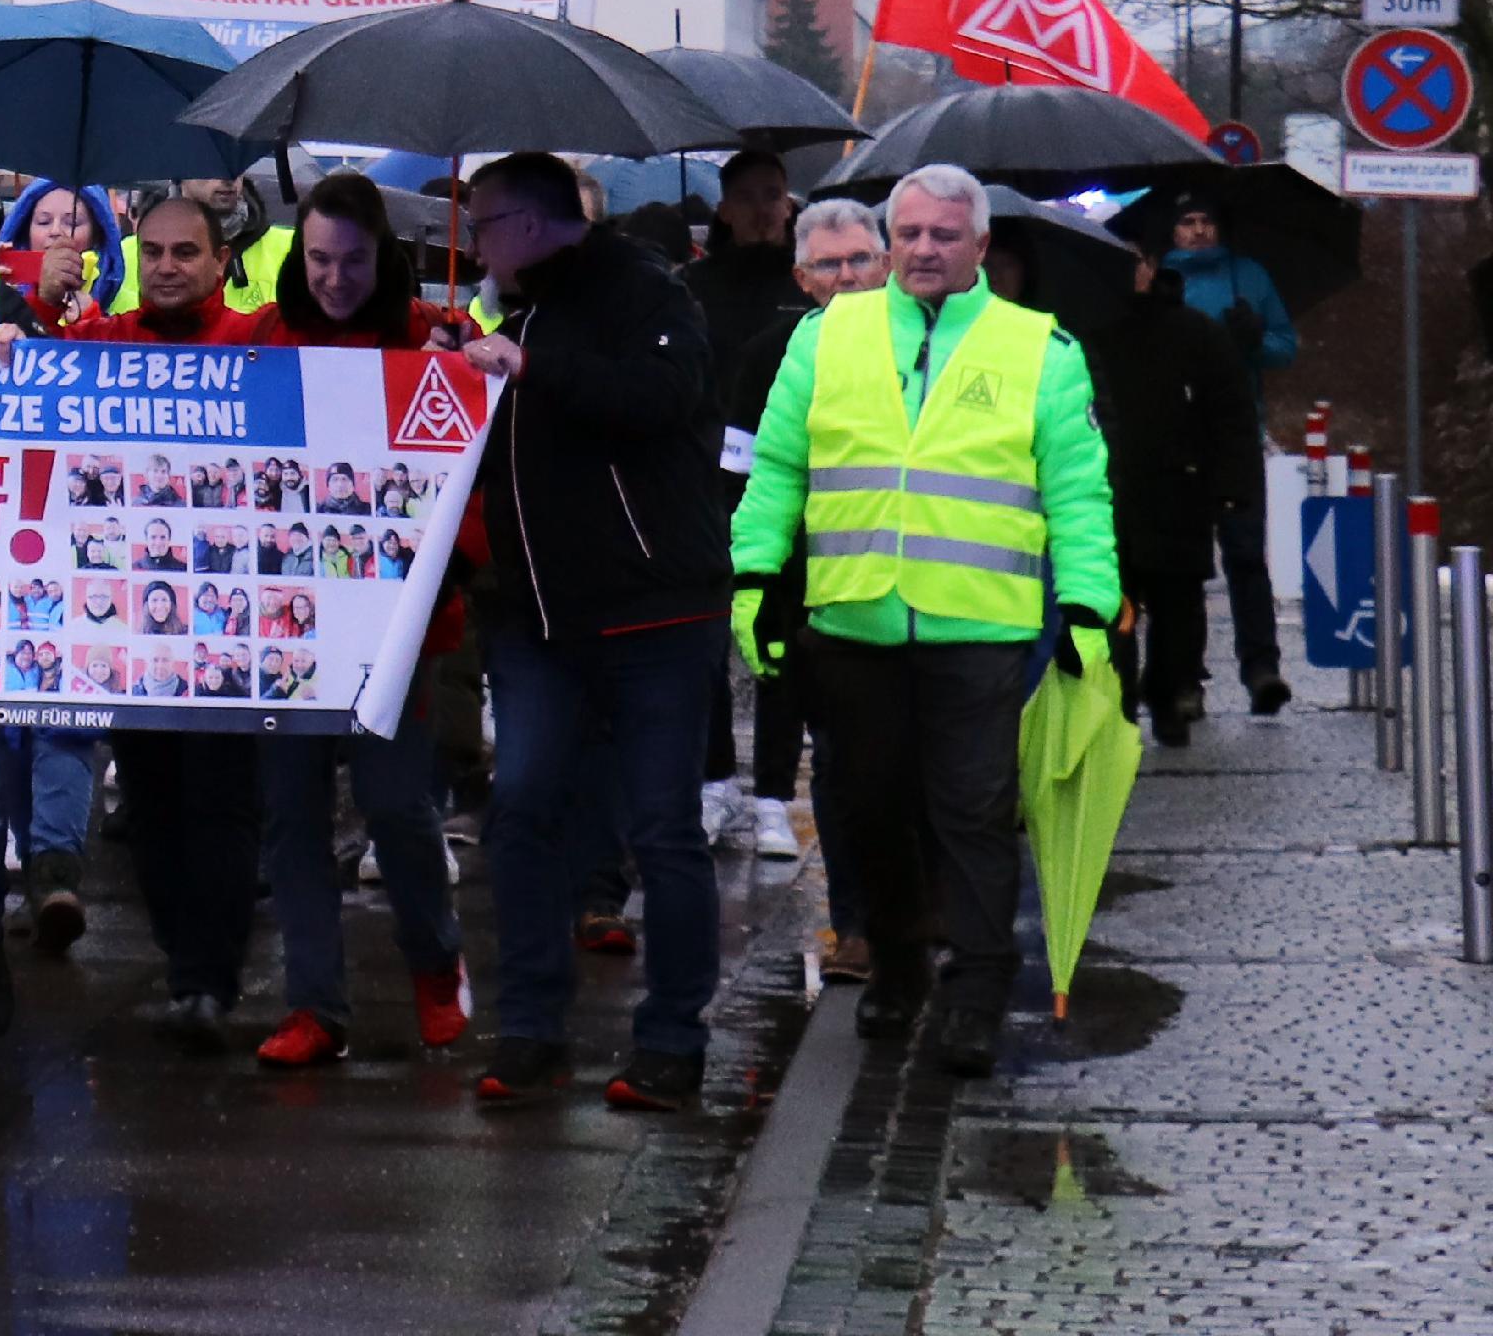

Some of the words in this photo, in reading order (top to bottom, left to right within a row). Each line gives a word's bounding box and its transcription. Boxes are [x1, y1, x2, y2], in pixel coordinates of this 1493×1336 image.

[96, 351, 244, 392] LEBEN!
[58, 395, 248, 439] SICHERN!
[6, 709, 38, 725] WIR
[41, 708, 72, 726] FÜR
[74, 711, 114, 728] NRW
